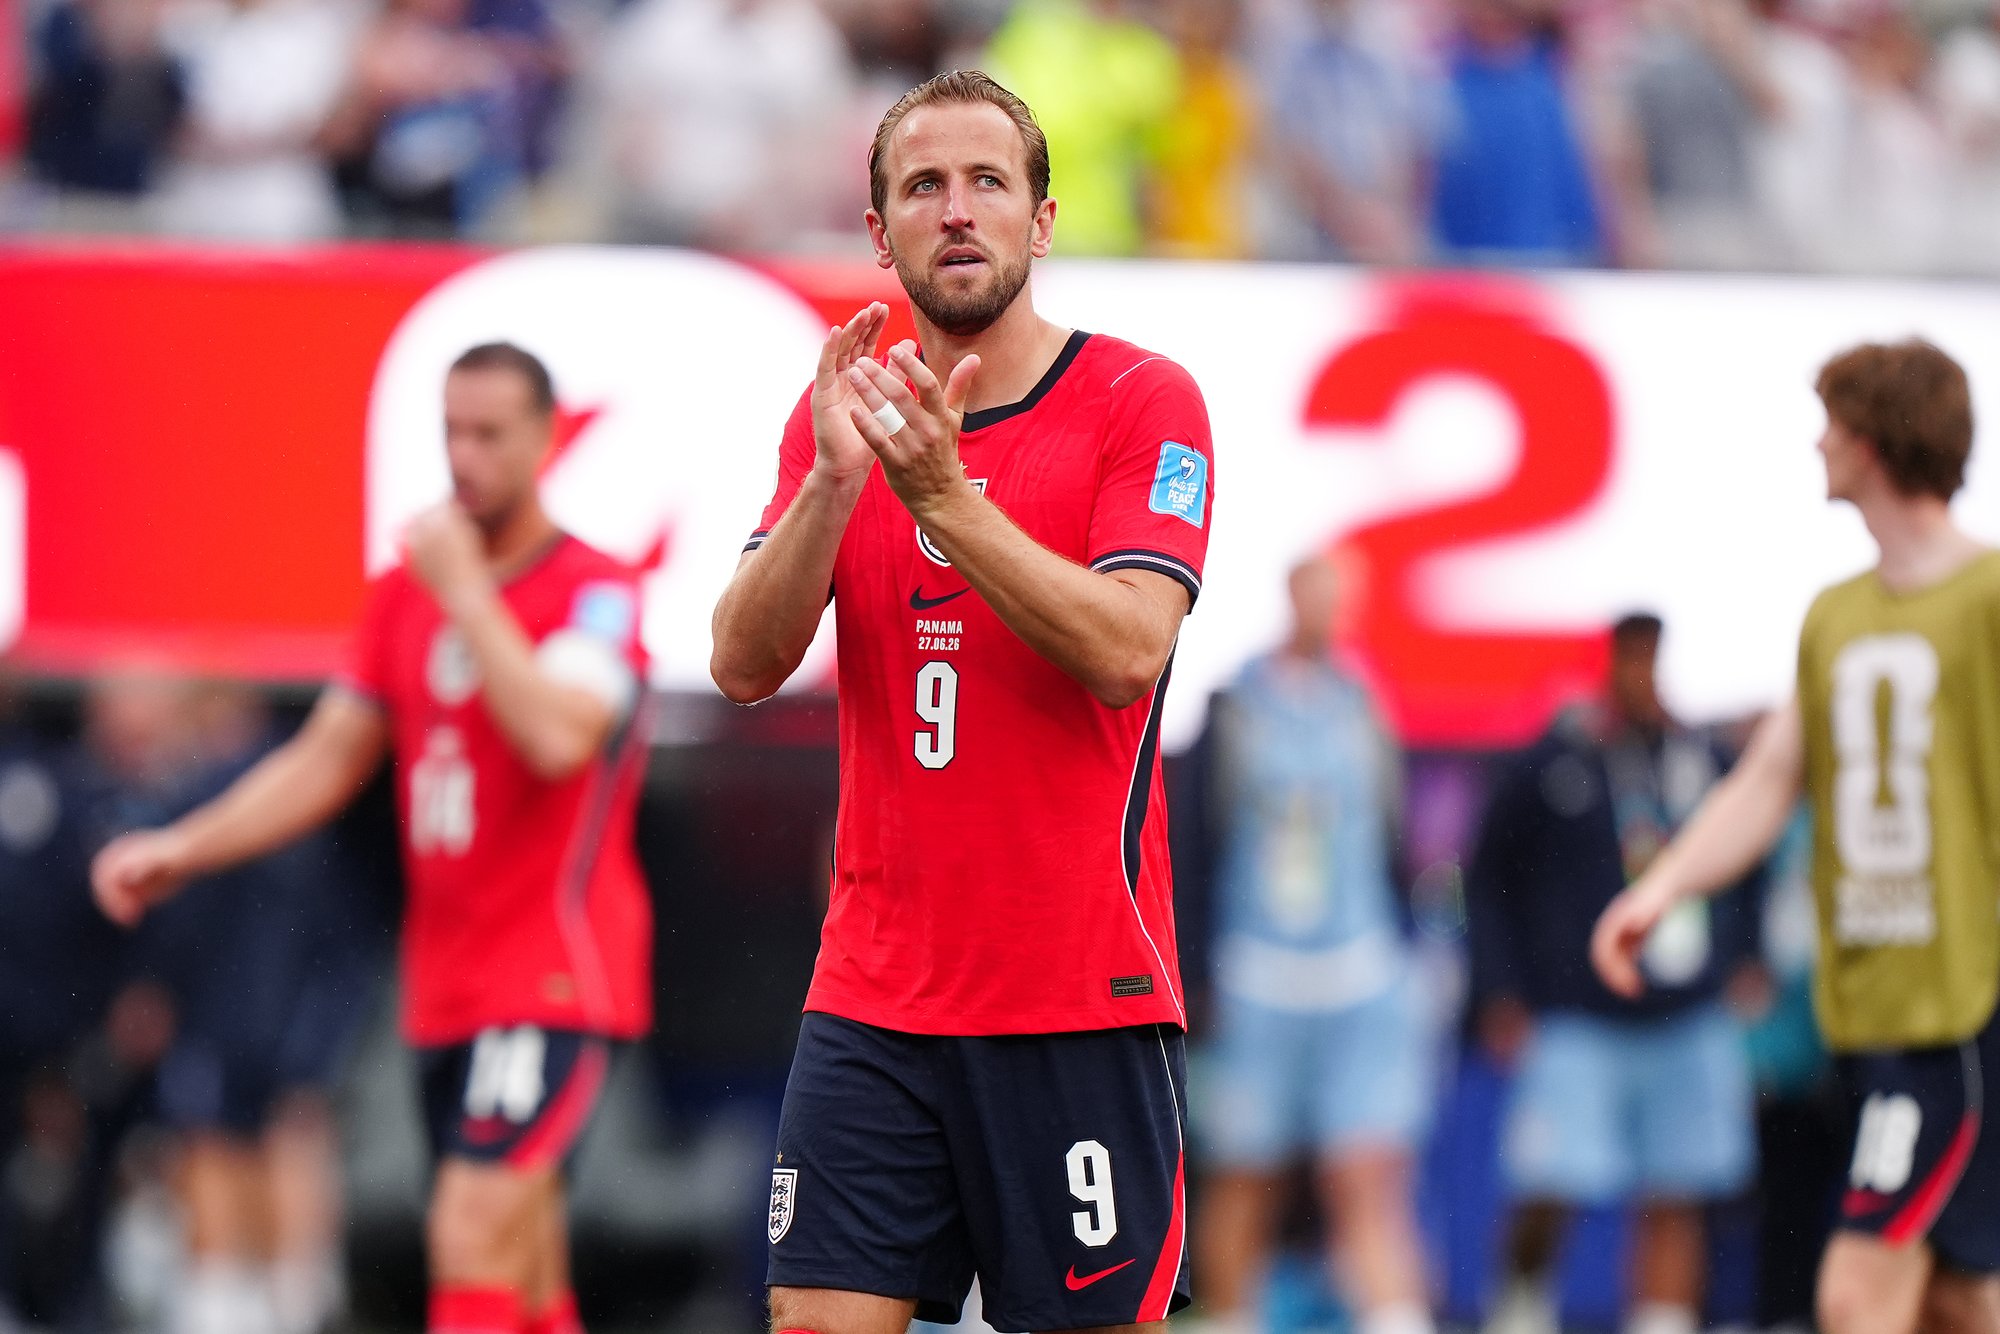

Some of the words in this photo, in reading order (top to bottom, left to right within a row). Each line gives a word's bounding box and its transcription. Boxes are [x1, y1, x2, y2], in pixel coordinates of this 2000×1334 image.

[1167, 489, 1196, 507] PEACE
[916, 619, 963, 634] PANAMA
[918, 637, 960, 651] 27.06.26
[914, 660, 959, 770] 9
[464, 1025, 544, 1122] 14
[1065, 1139, 1118, 1248] 9
